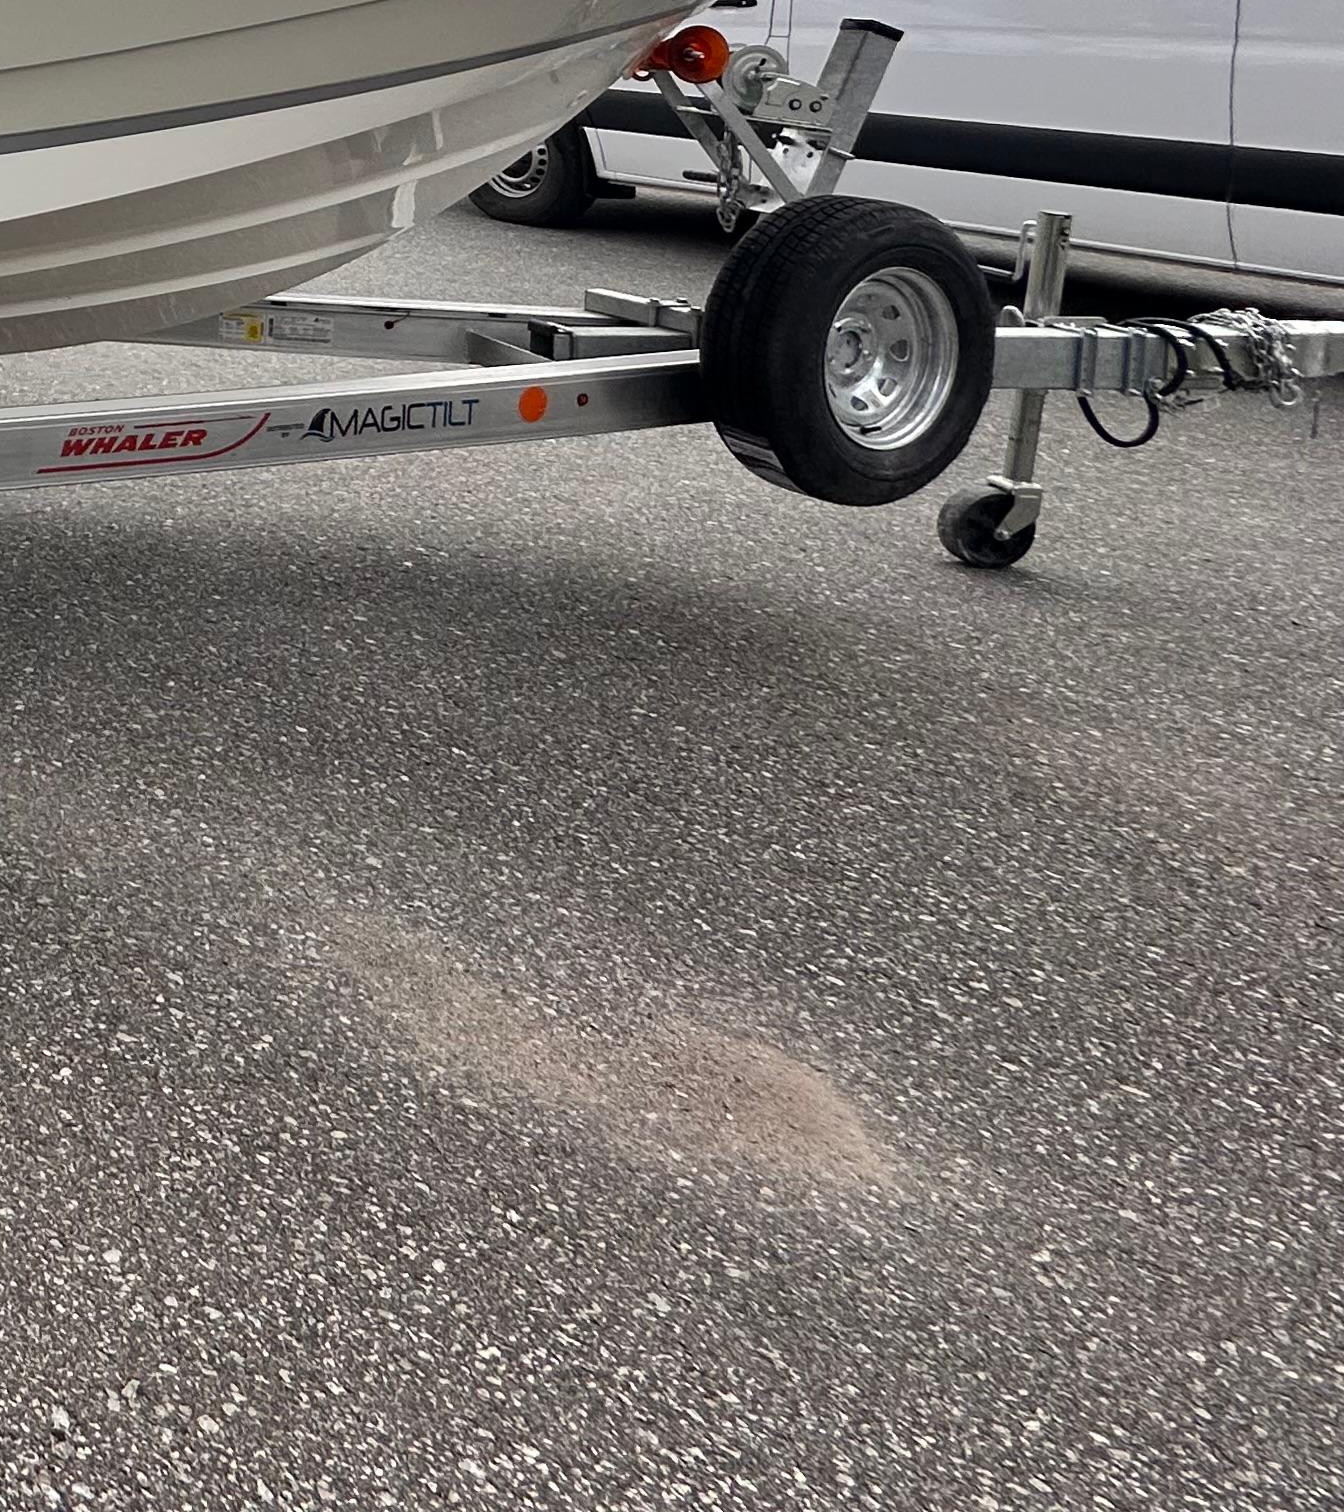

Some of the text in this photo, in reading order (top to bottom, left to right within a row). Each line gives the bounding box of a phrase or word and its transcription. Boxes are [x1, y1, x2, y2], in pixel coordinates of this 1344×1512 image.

[68, 424, 125, 437] BOSTON
[330, 399, 480, 437] MAGICTILT
[60, 429, 208, 457] WHALER
